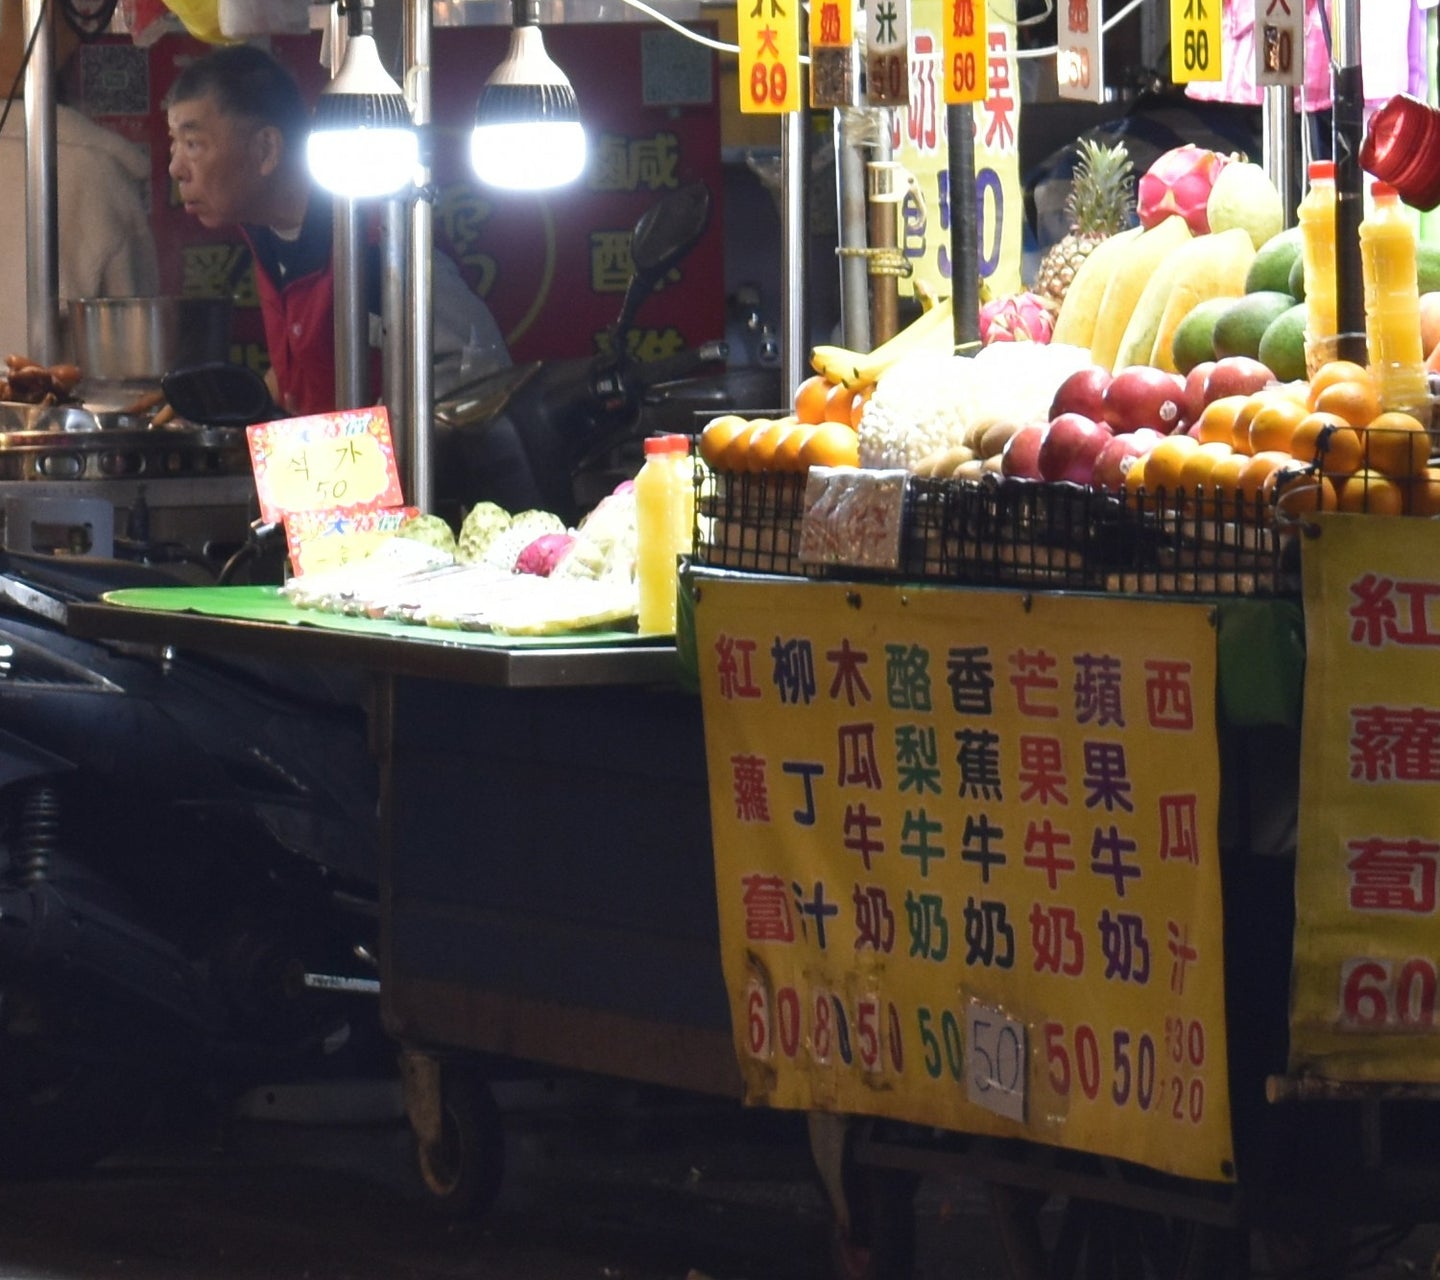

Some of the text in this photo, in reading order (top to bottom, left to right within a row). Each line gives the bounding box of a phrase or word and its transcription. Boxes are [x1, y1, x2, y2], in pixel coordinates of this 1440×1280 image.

[714, 633, 796, 946] 紅蘿蔔
[770, 635, 839, 951] 柳丁汁
[826, 638, 897, 955] 木瓜牛奶
[884, 642, 949, 964] 酪梨牛奶
[945, 645, 1017, 970] 香蕉牛奶
[1008, 647, 1087, 978] 芒果牛奶
[1073, 652, 1151, 985] 蘋果牛奶
[1144, 658, 1202, 996] 西瓜汁
[747, 985, 801, 1059] 60
[918, 1006, 963, 1080] 50
[973, 1019, 1019, 1092] 50
[1046, 1020, 1101, 1101] 50
[1112, 1029, 1157, 1112] 50
[1344, 959, 1437, 1028] 60
